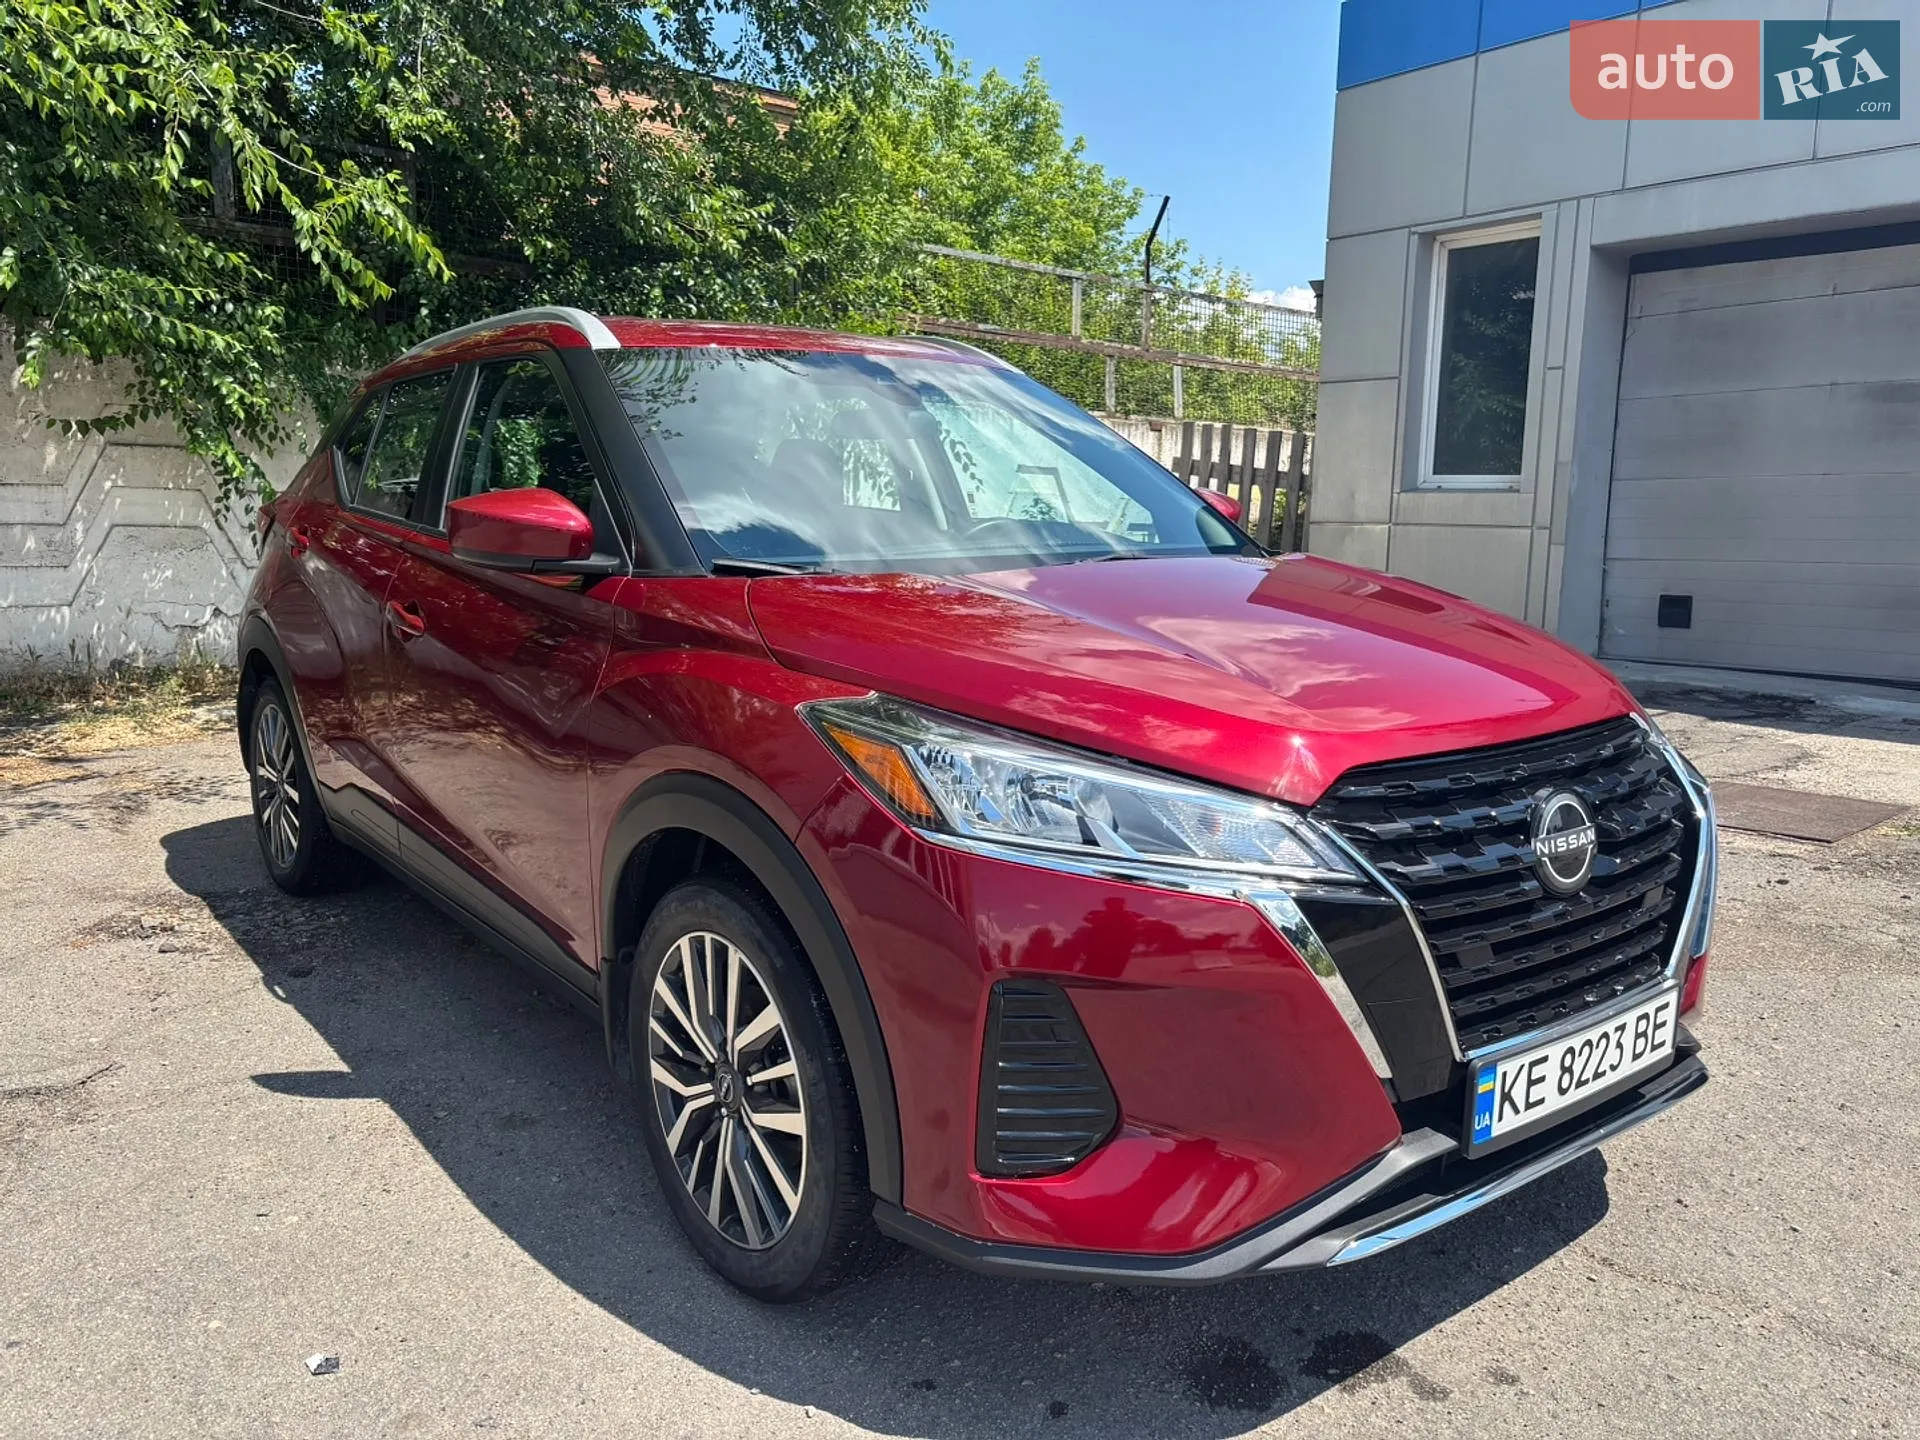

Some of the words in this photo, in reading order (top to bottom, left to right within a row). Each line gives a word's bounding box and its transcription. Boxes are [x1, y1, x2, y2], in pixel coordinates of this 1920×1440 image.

[1536, 827, 1595, 856] NISSAN
[1497, 1054, 1549, 1123] KE
[1557, 1022, 1627, 1096] 8223
[1631, 1001, 1670, 1064] BE
[1474, 1113, 1491, 1131] UA
